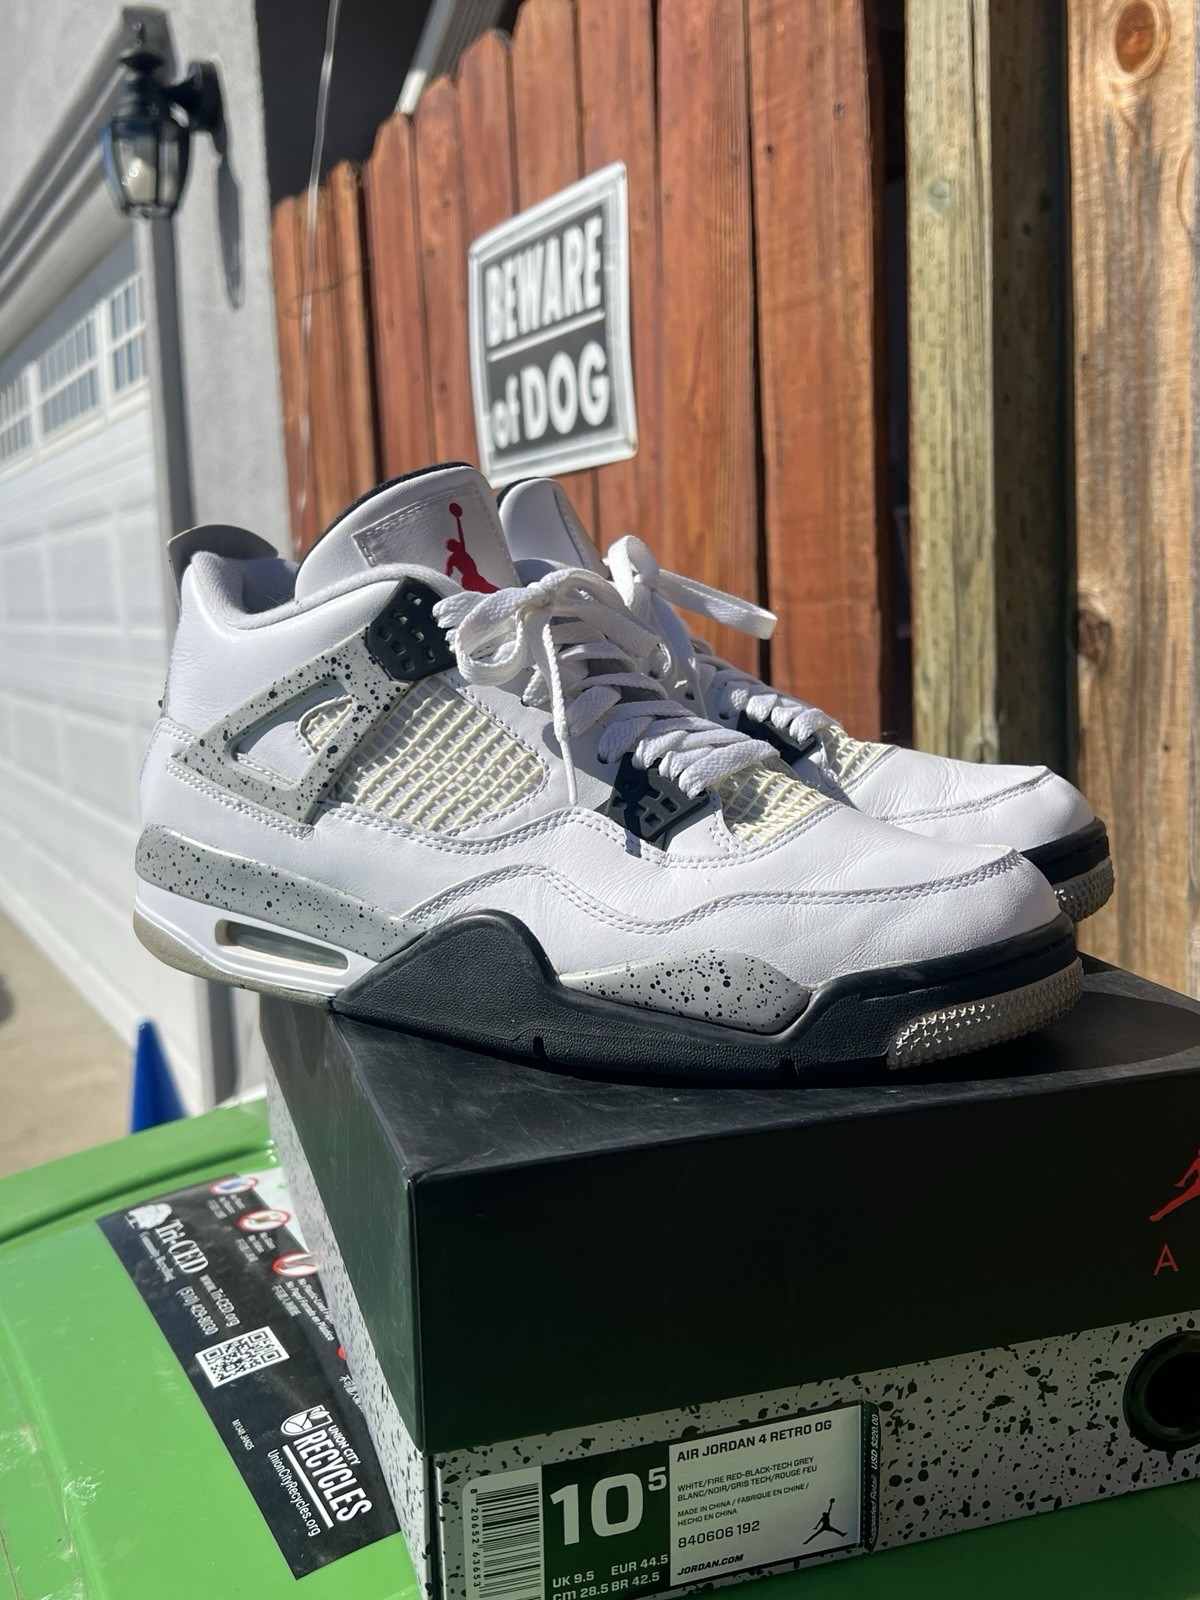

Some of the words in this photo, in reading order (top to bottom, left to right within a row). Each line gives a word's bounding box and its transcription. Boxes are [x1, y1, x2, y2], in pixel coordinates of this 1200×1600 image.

[485, 214, 603, 348] BEWARE
[491, 374, 520, 449] of
[520, 340, 610, 440] DOG
[155, 1219, 209, 1274] Tri-CED
[1153, 1243, 1179, 1276] A
[199, 1273, 241, 1328] www.Tri-CED.org
[327, 1424, 351, 1450] UNION
[343, 1447, 361, 1466] CITY
[676, 1448, 699, 1463] AIR
[702, 1436, 756, 1457] JORDAN
[758, 1433, 767, 1444] 4
[770, 1424, 812, 1443] RETRO
[815, 1420, 832, 1432] OG
[870, 1413, 879, 1449] $220.00
[292, 1429, 374, 1522] RECYCLES
[677, 1473, 725, 1492] WHITE/FIRE
[726, 1461, 793, 1482] RED-BLACK-TECH
[794, 1456, 814, 1467] GREY
[870, 1449, 878, 1470] USD
[267, 1448, 321, 1538] UnionCityRecycles.org
[677, 1479, 750, 1502] BLANC/NOIR/GRIS
[751, 1469, 801, 1487] TECH/ROUGE
[802, 1465, 818, 1475] FEU
[677, 1507, 698, 1518] MADE
[700, 1505, 708, 1513] IN
[709, 1500, 731, 1511] CHINA
[737, 1491, 772, 1504] FABRIQUE
[773, 1488, 783, 1496] EN
[783, 1483, 805, 1495] CHINE
[471, 1507, 480, 1544] 20652
[677, 1515, 702, 1527] HECHO
[704, 1513, 714, 1521] EN
[715, 1508, 738, 1519] CHINA
[678, 1526, 734, 1549] 840606
[737, 1520, 760, 1536] 192
[472, 1552, 481, 1587] 63653
[552, 1575, 571, 1588] UK
[574, 1571, 595, 1584] 9.5
[611, 1561, 637, 1576] EUR
[640, 1554, 669, 1568] 44.5
[677, 1554, 744, 1576] JORDAN.COM
[580, 1583, 609, 1598] 28.5
[611, 1579, 629, 1591] BR
[631, 1572, 660, 1585] 42.5
